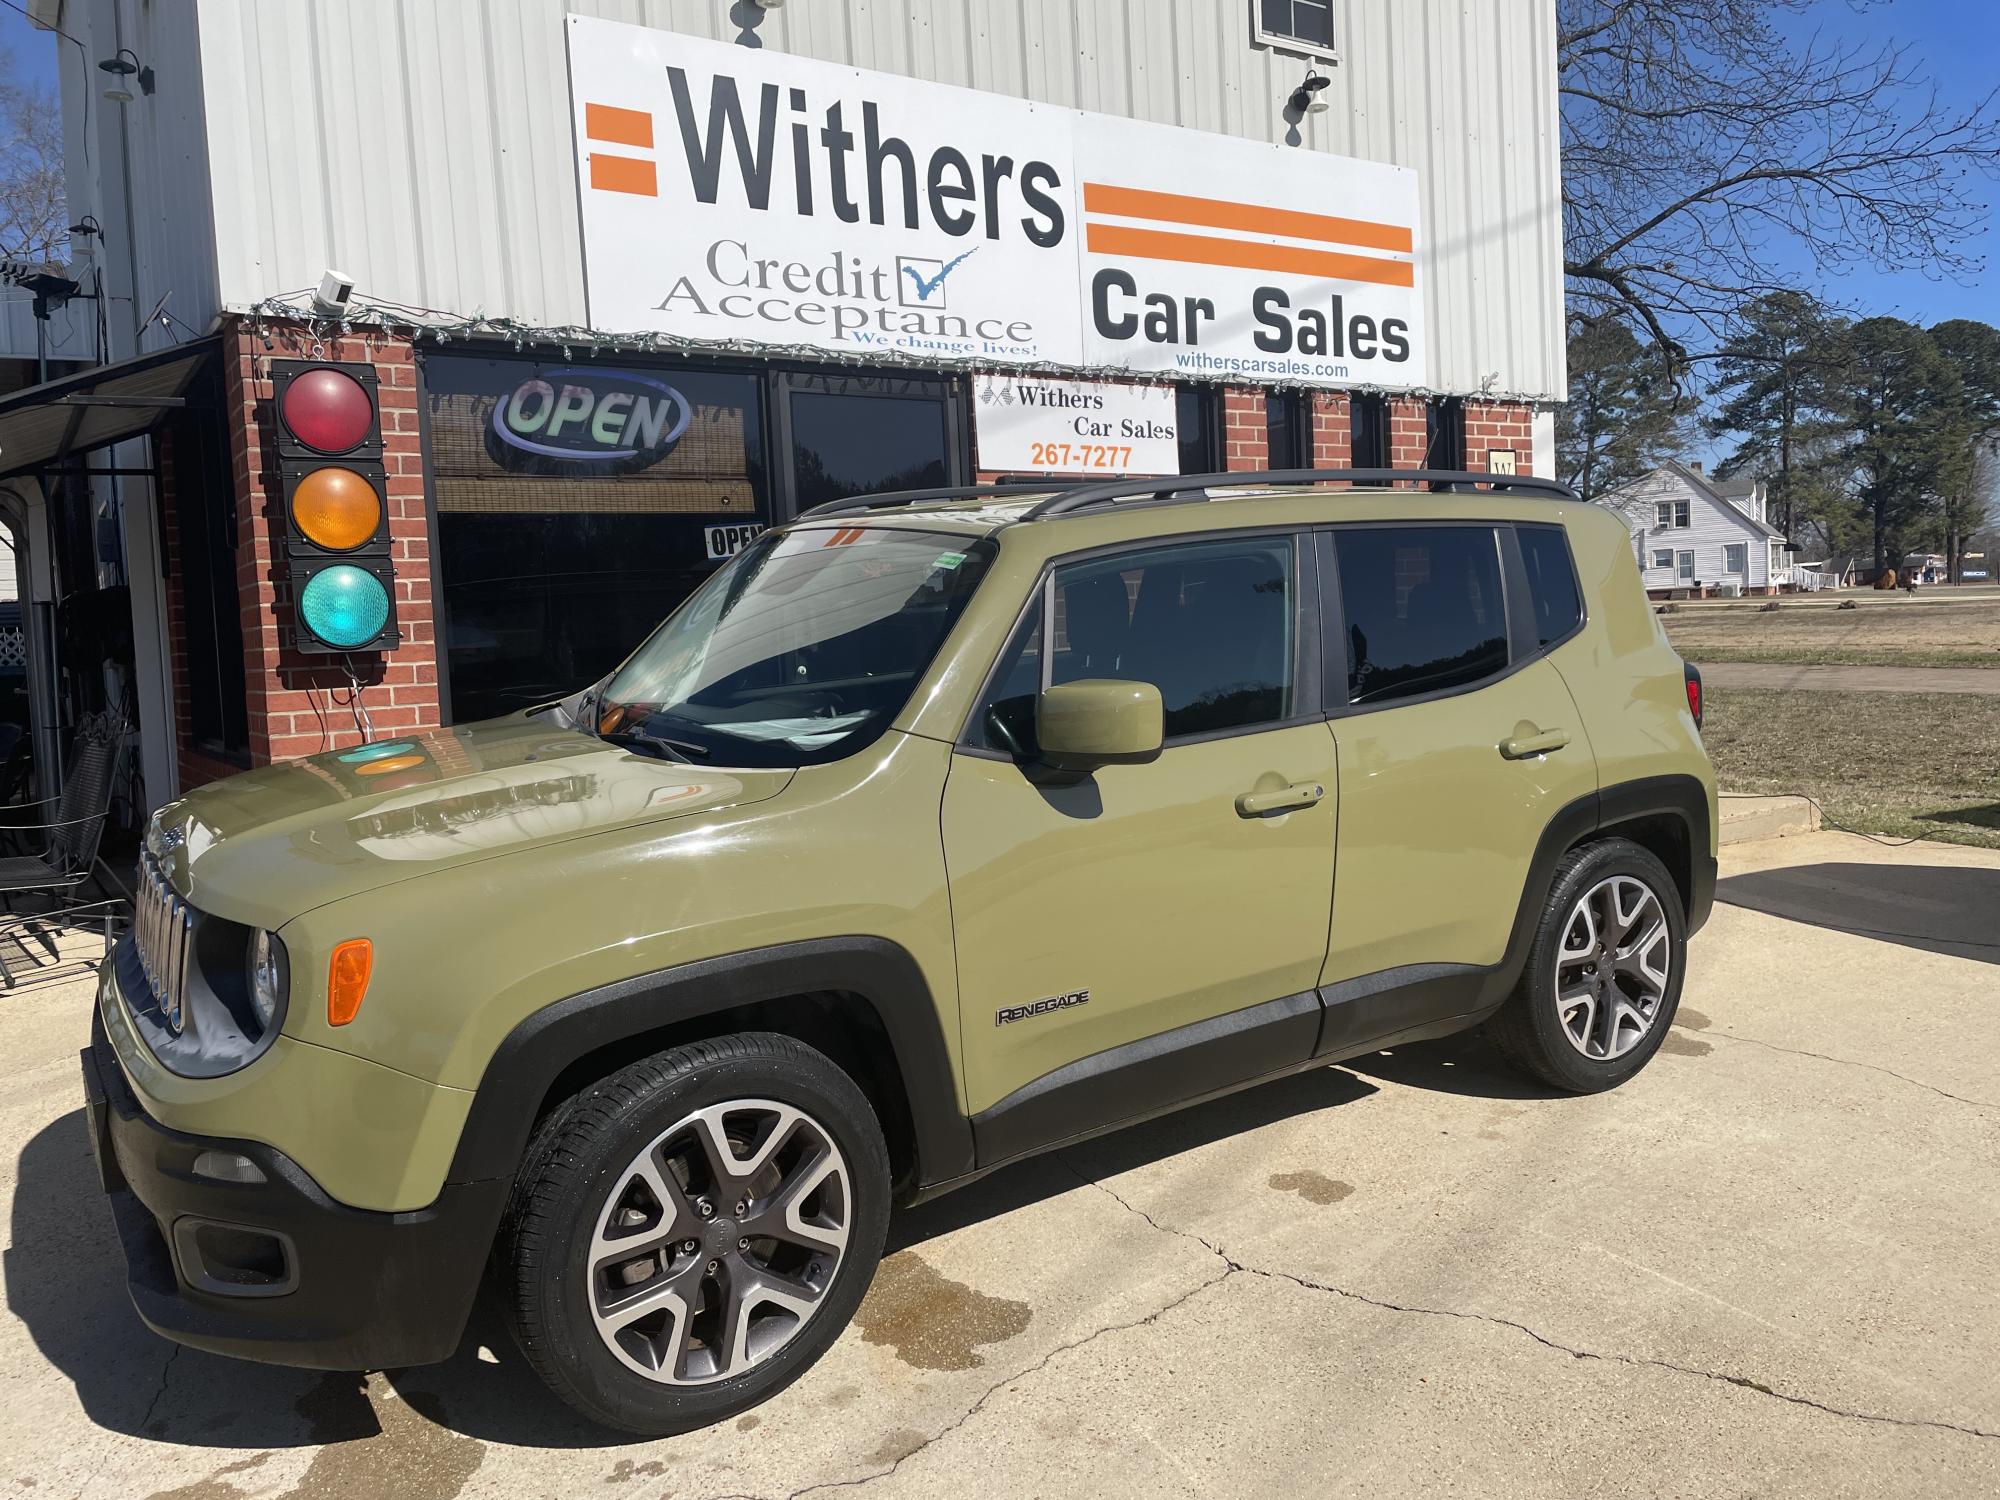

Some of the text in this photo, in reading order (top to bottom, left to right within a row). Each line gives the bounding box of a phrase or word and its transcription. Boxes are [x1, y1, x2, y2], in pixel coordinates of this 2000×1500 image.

[667, 66, 1065, 248] Withers
[706, 239, 891, 302] Credit
[651, 275, 1033, 343] Acceptance
[1092, 268, 1410, 363] Car Sales
[852, 331, 1038, 357] We change lives!
[1176, 352, 1349, 378] witherscarsales.com
[508, 379, 672, 450] OPEN
[1017, 385, 1103, 410] Withers
[1073, 416, 1175, 440] Car Sales
[1031, 442, 1132, 468] 267-7277
[996, 988, 1089, 1026] RENEGADE
